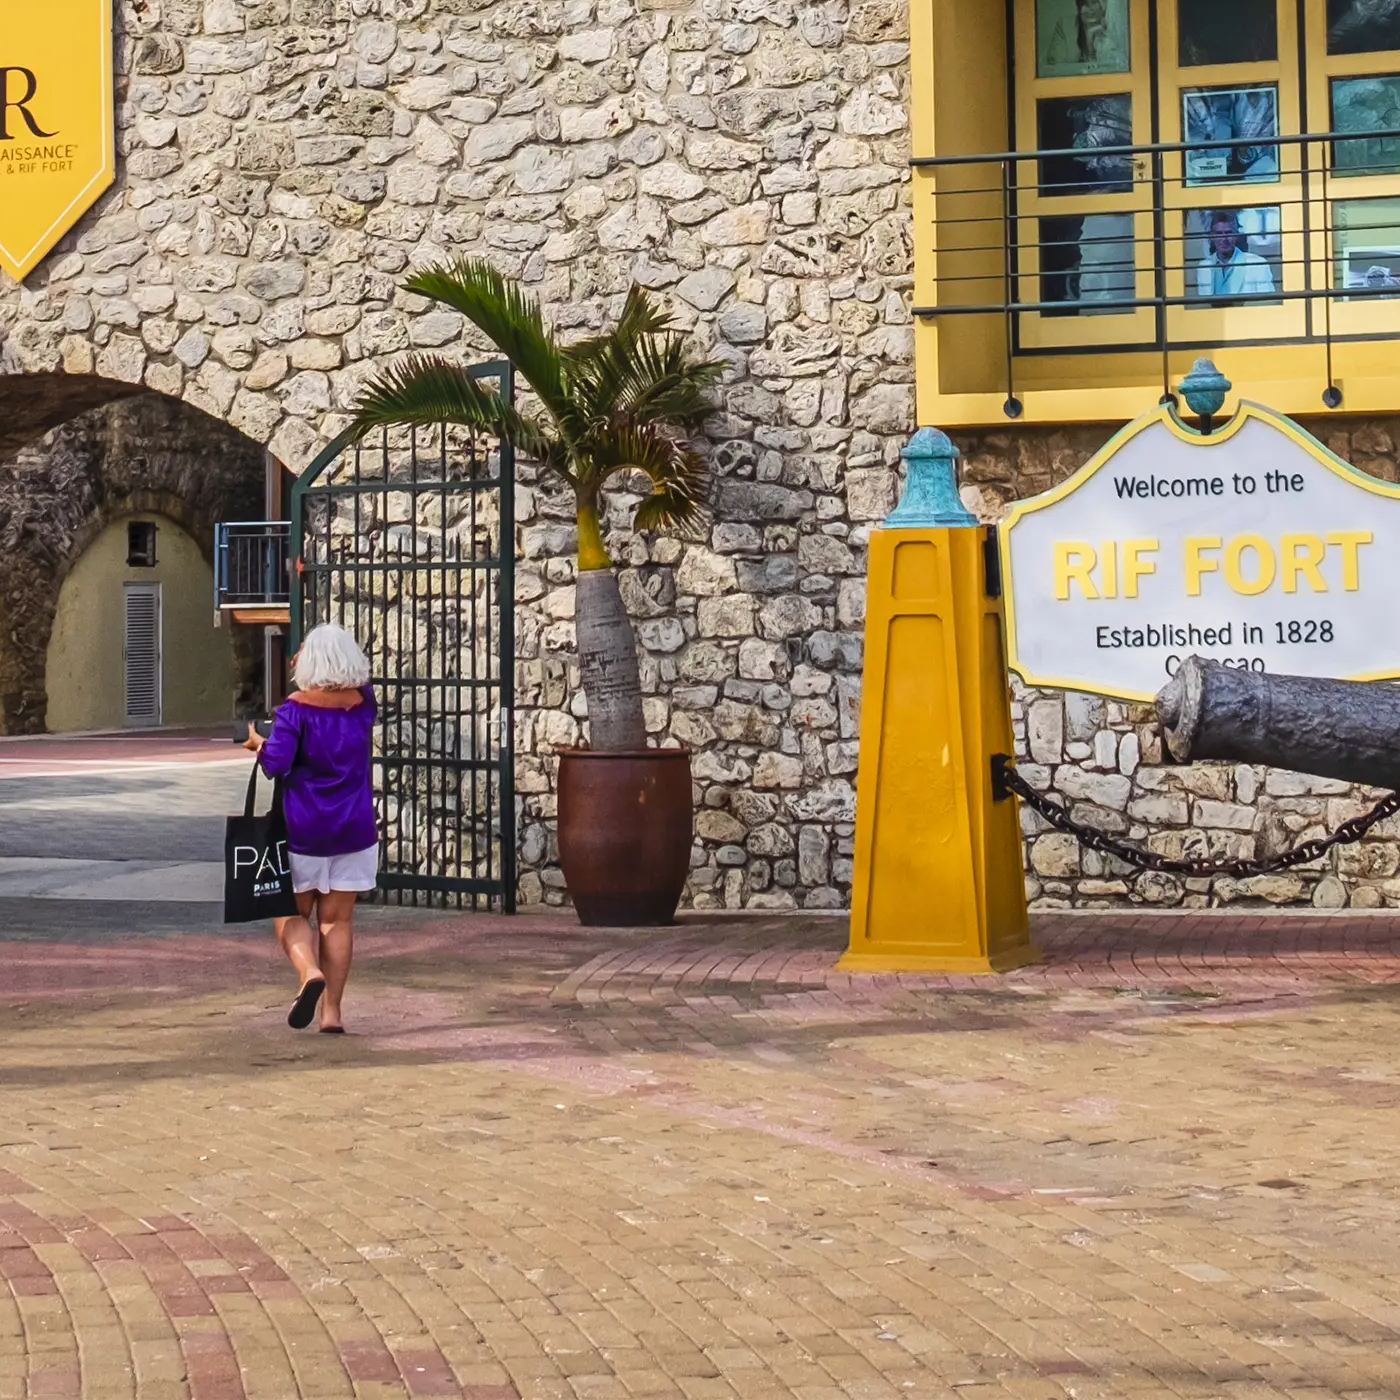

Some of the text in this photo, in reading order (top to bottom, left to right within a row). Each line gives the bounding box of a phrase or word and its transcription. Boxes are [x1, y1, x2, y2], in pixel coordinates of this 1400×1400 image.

[6, 163, 15, 175] &
[19, 162, 37, 174] RIF
[42, 160, 74, 173] FORT
[1113, 469, 1304, 499] Welcome to the
[1053, 531, 1373, 600] RIF FORT
[1096, 620, 1335, 649] Established in 1828
